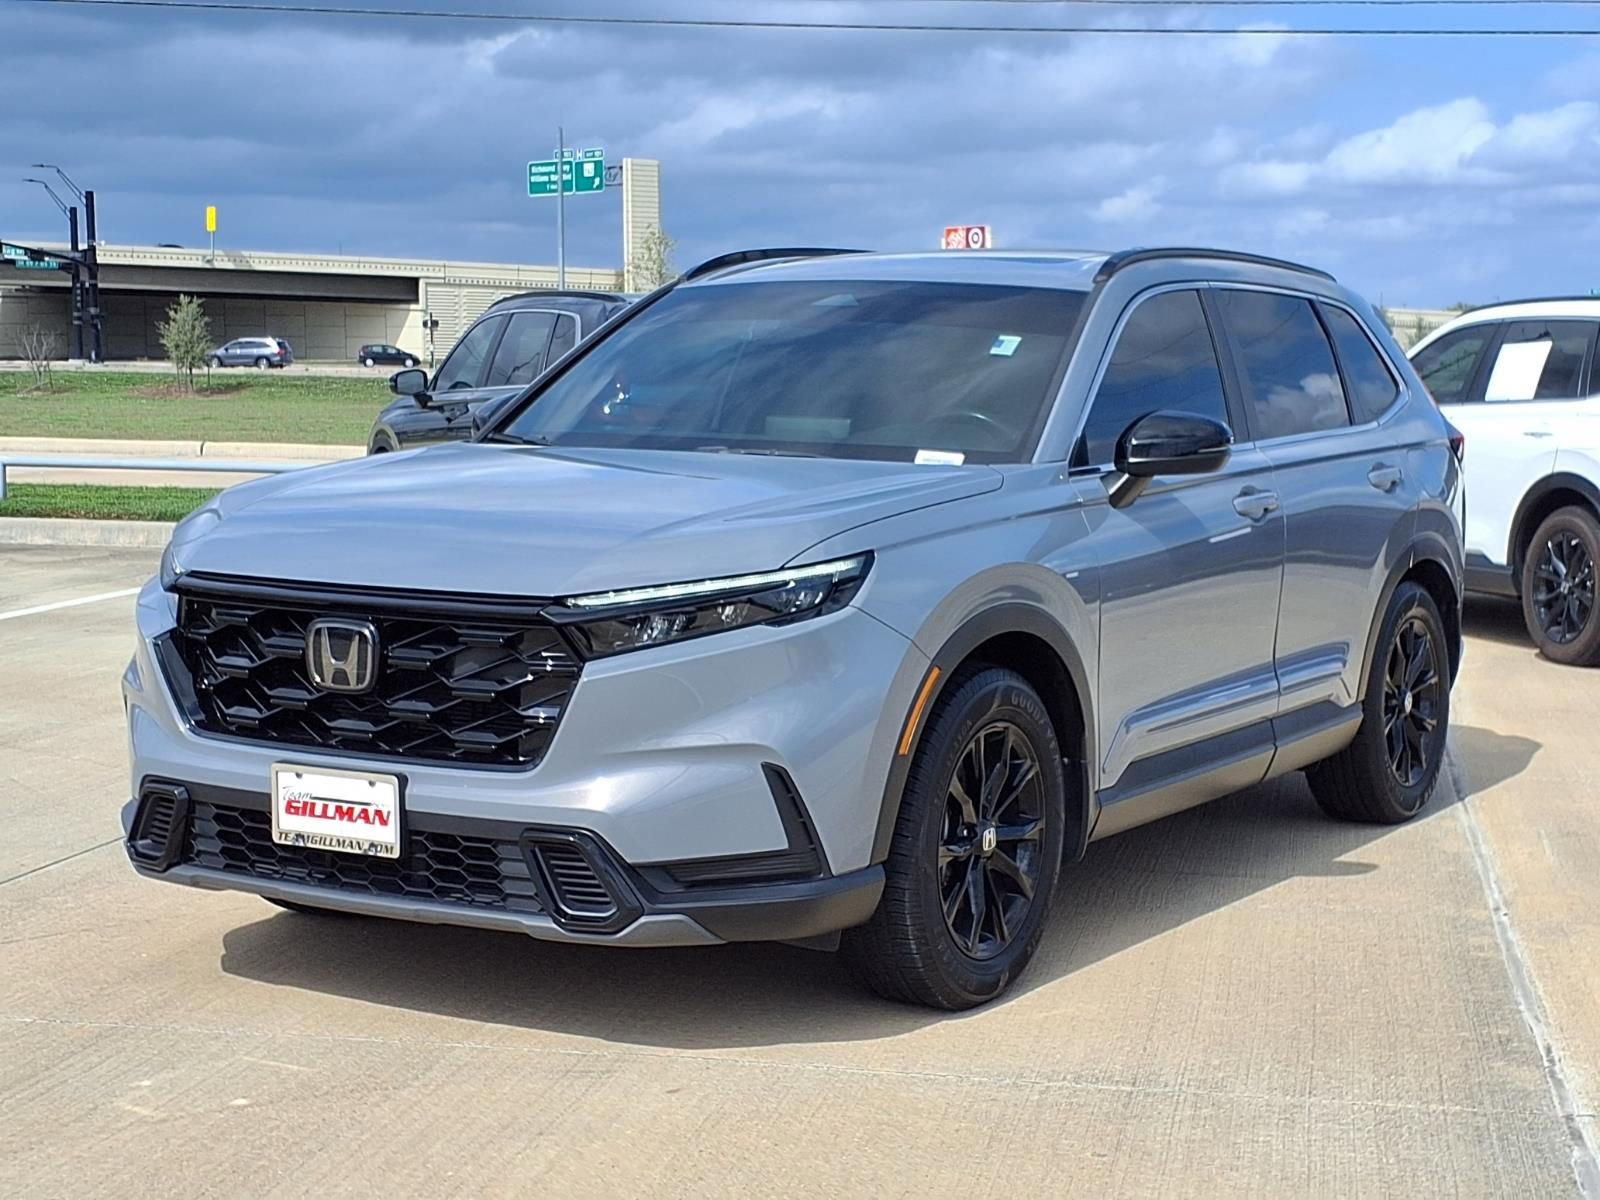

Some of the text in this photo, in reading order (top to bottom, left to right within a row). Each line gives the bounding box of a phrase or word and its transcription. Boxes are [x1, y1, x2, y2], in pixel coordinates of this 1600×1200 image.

[282, 785, 313, 801] Team
[285, 799, 391, 827] GILLMAN
[278, 831, 395, 856] TEGILLMAN.OM
